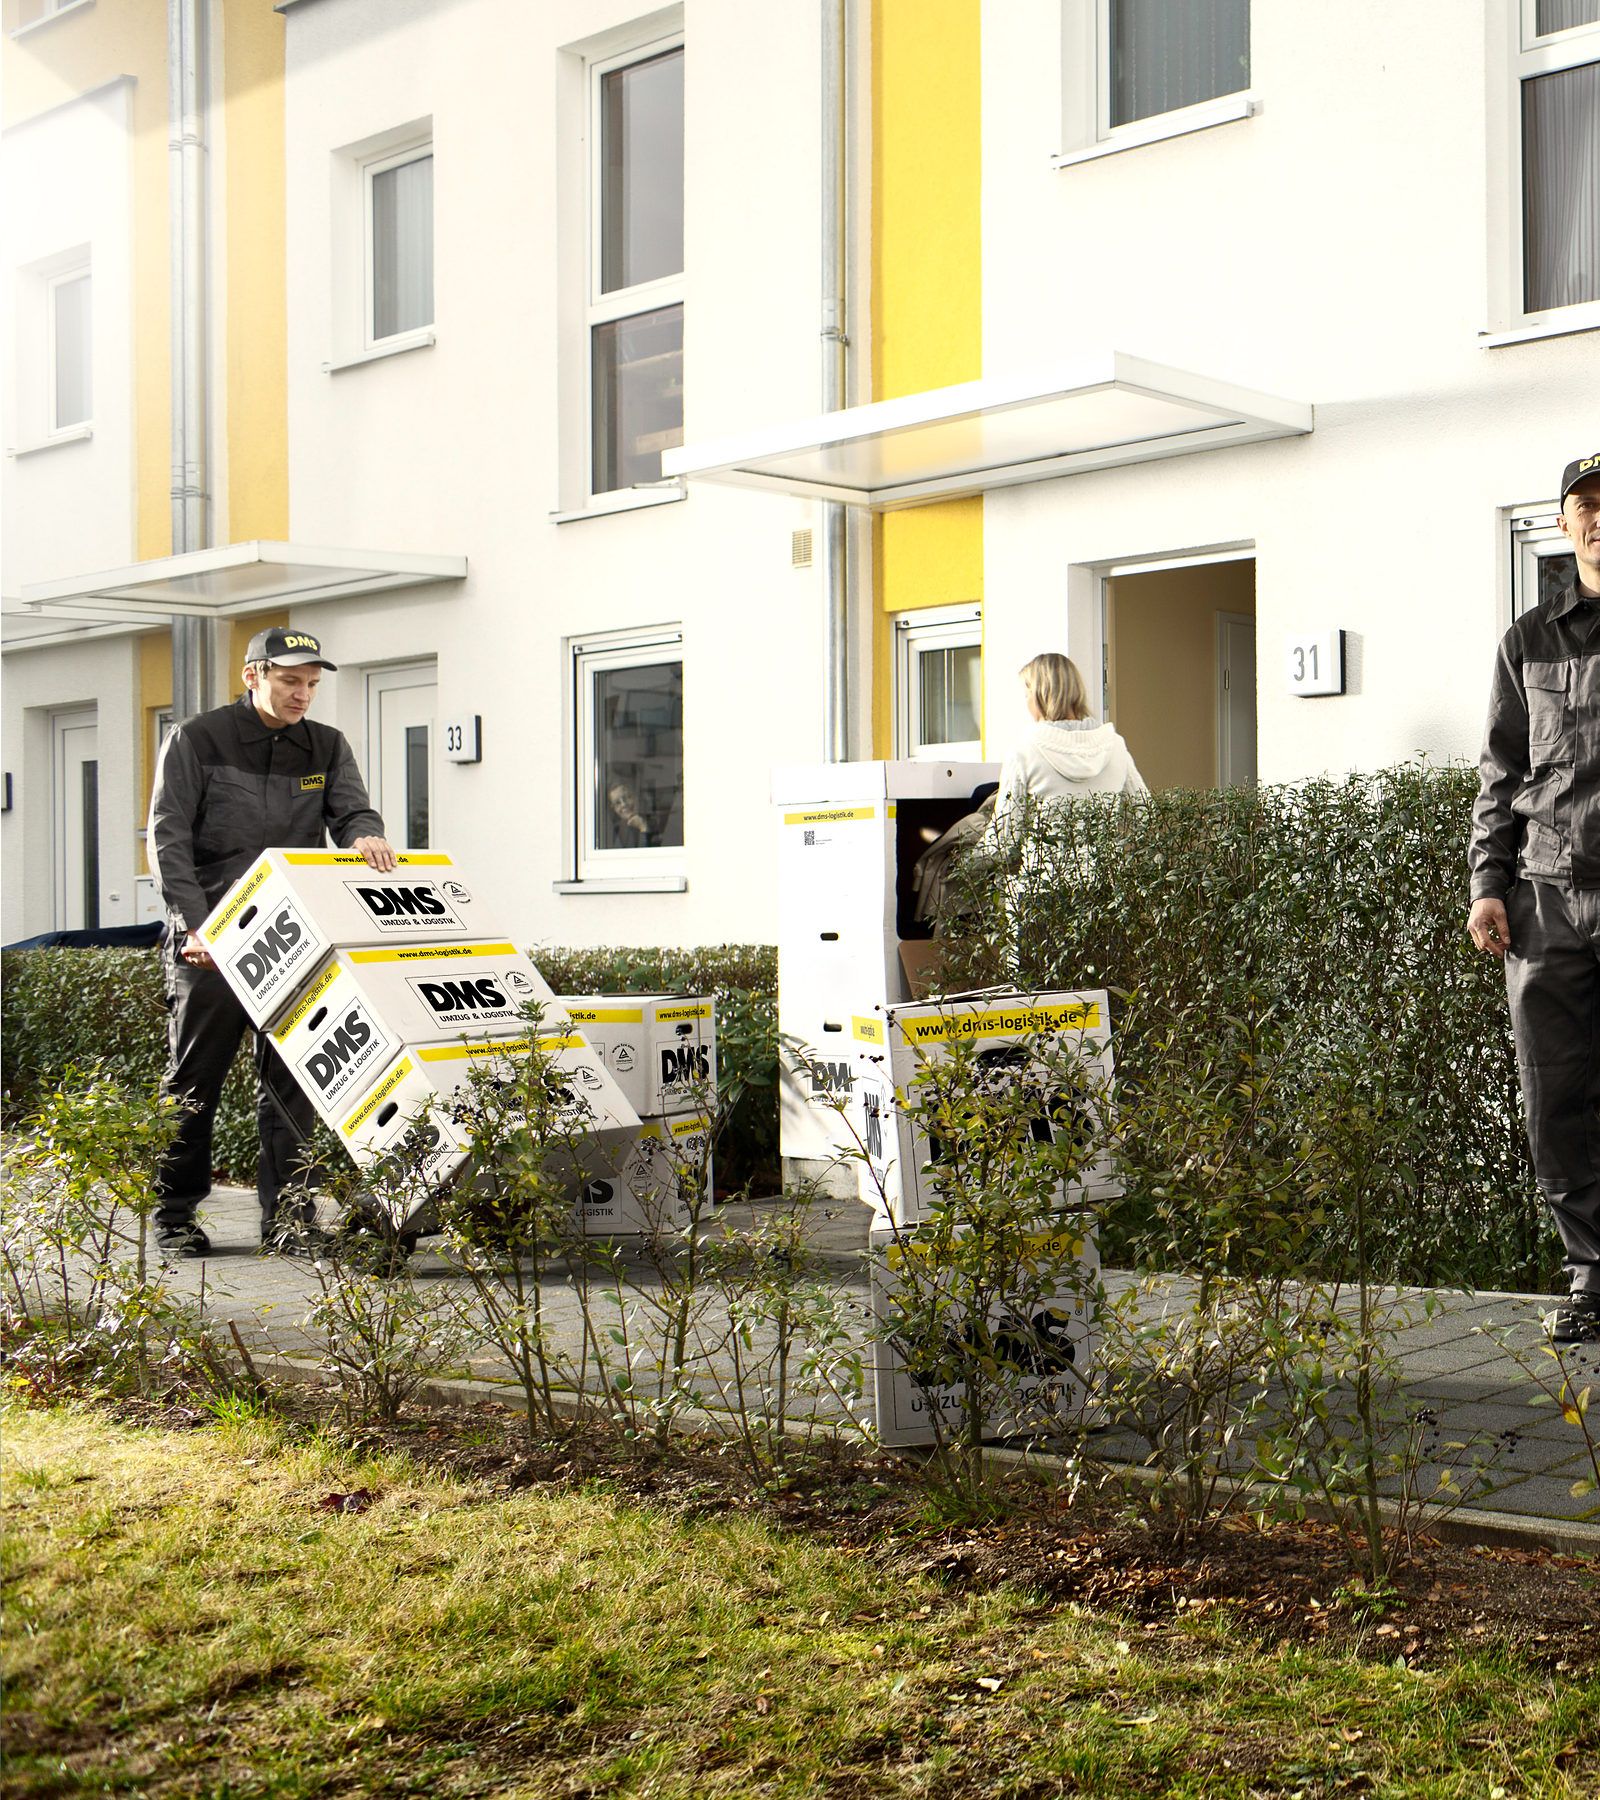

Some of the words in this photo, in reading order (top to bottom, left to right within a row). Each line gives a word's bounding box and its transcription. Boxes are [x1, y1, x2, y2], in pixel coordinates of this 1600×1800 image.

[284, 636, 318, 650] DMS
[1293, 644, 1319, 682] 31
[447, 725, 462, 751] 33
[302, 775, 323, 786] DMS
[803, 811, 854, 820] www.dms-logistik.de
[211, 872, 264, 936] www.dms-logistik.de
[355, 886, 446, 916] DMS
[380, 918, 411, 926] UMZUG
[413, 918, 421, 926] &
[421, 917, 456, 925] LOGISTIK
[235, 909, 301, 991] DMS
[398, 948, 472, 958] www.dms-logistik.de
[256, 974, 279, 1000] UMZUG
[278, 967, 285, 976] &
[284, 938, 311, 968] LOGISTIK
[279, 972, 333, 1037] www.dms-logistik.de
[417, 978, 507, 1012] DMS
[439, 1012, 471, 1023] UMZUG
[472, 1012, 481, 1020] &
[481, 1009, 516, 1019] LOGISTIK
[305, 1009, 371, 1091] DMS
[661, 1044, 710, 1084] DMS
[325, 1074, 349, 1100] UMZUG
[348, 1067, 355, 1076] &
[354, 1038, 380, 1069] LOGISTIK
[812, 1062, 853, 1093] DM
[348, 1068, 404, 1130] www.dms-logistik.de
[423, 1141, 450, 1172] LOGISTIK
